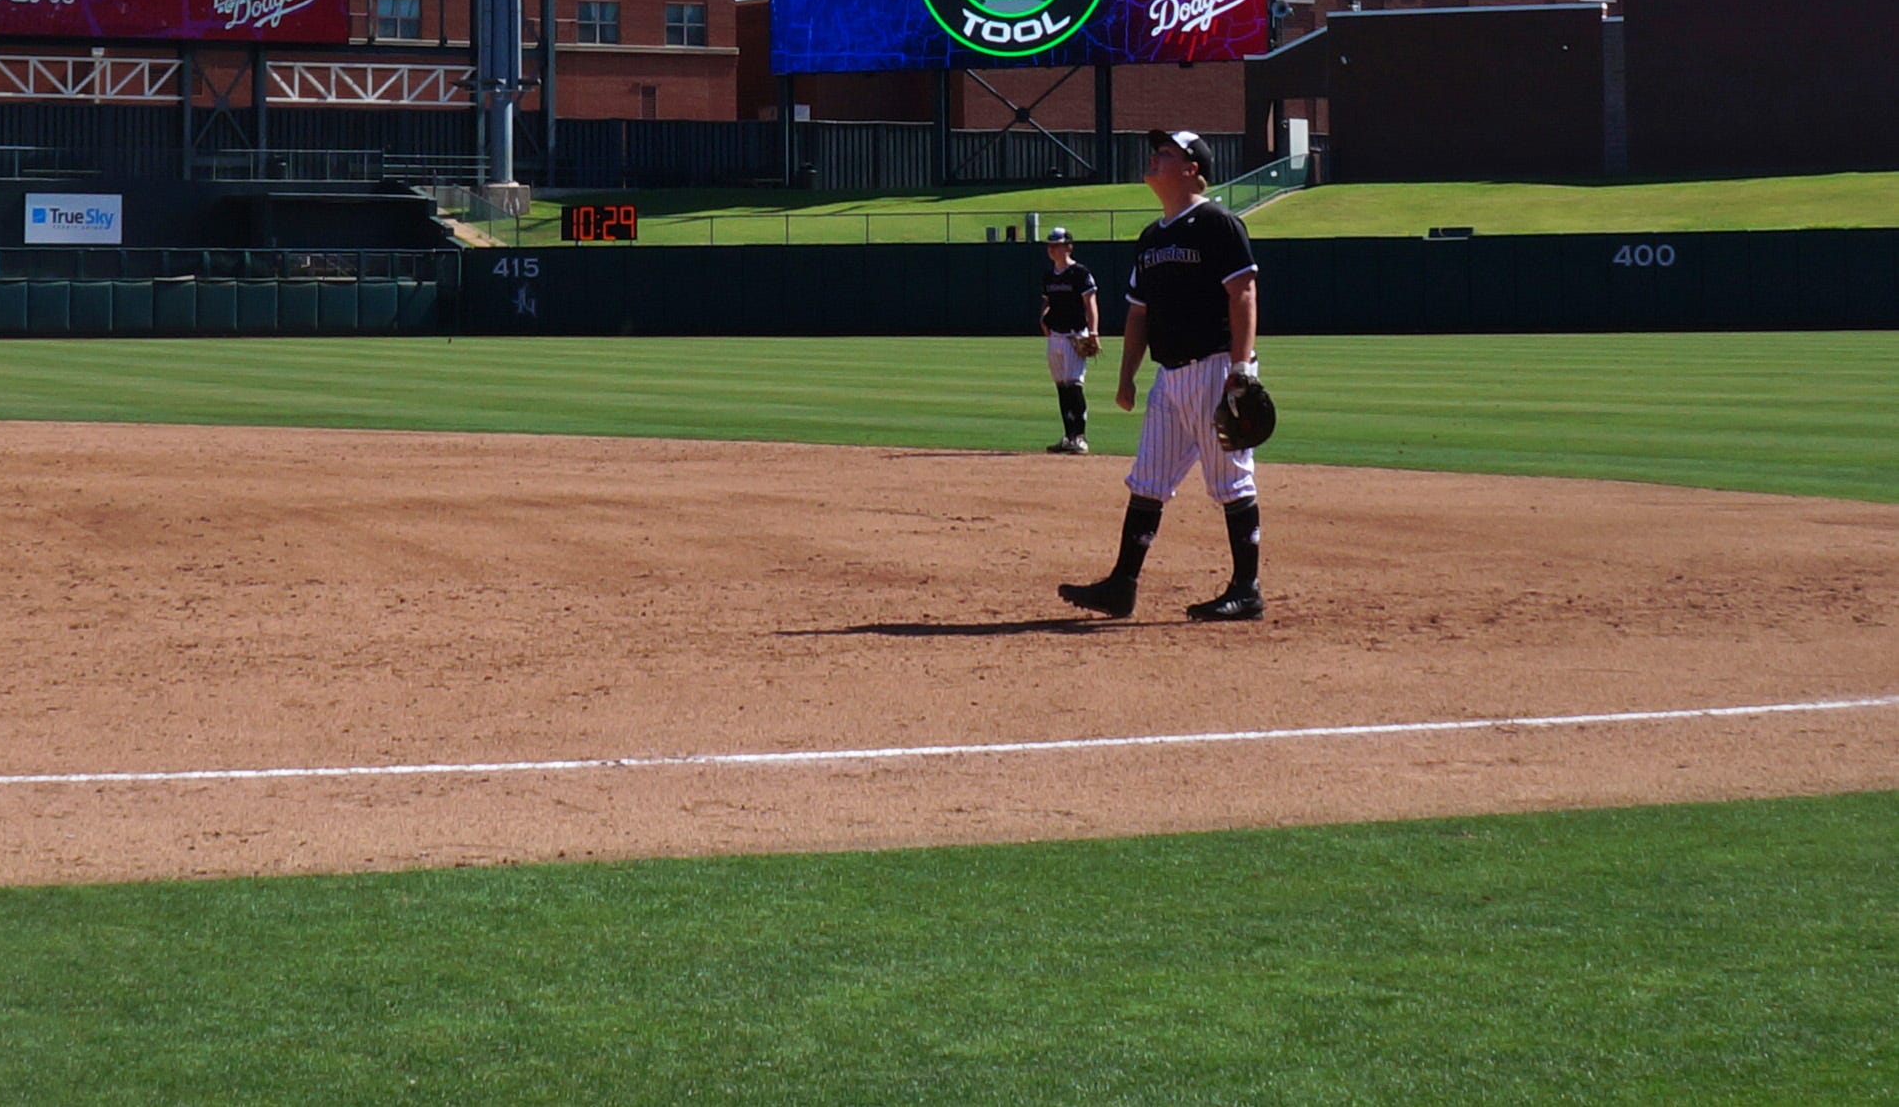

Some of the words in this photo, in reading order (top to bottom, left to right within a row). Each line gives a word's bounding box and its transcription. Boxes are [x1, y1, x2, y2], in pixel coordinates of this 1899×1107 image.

[961, 7, 1071, 43] TOOL
[572, 205, 635, 241] 10:29
[492, 257, 540, 278] 415
[1612, 243, 1676, 267] 400
